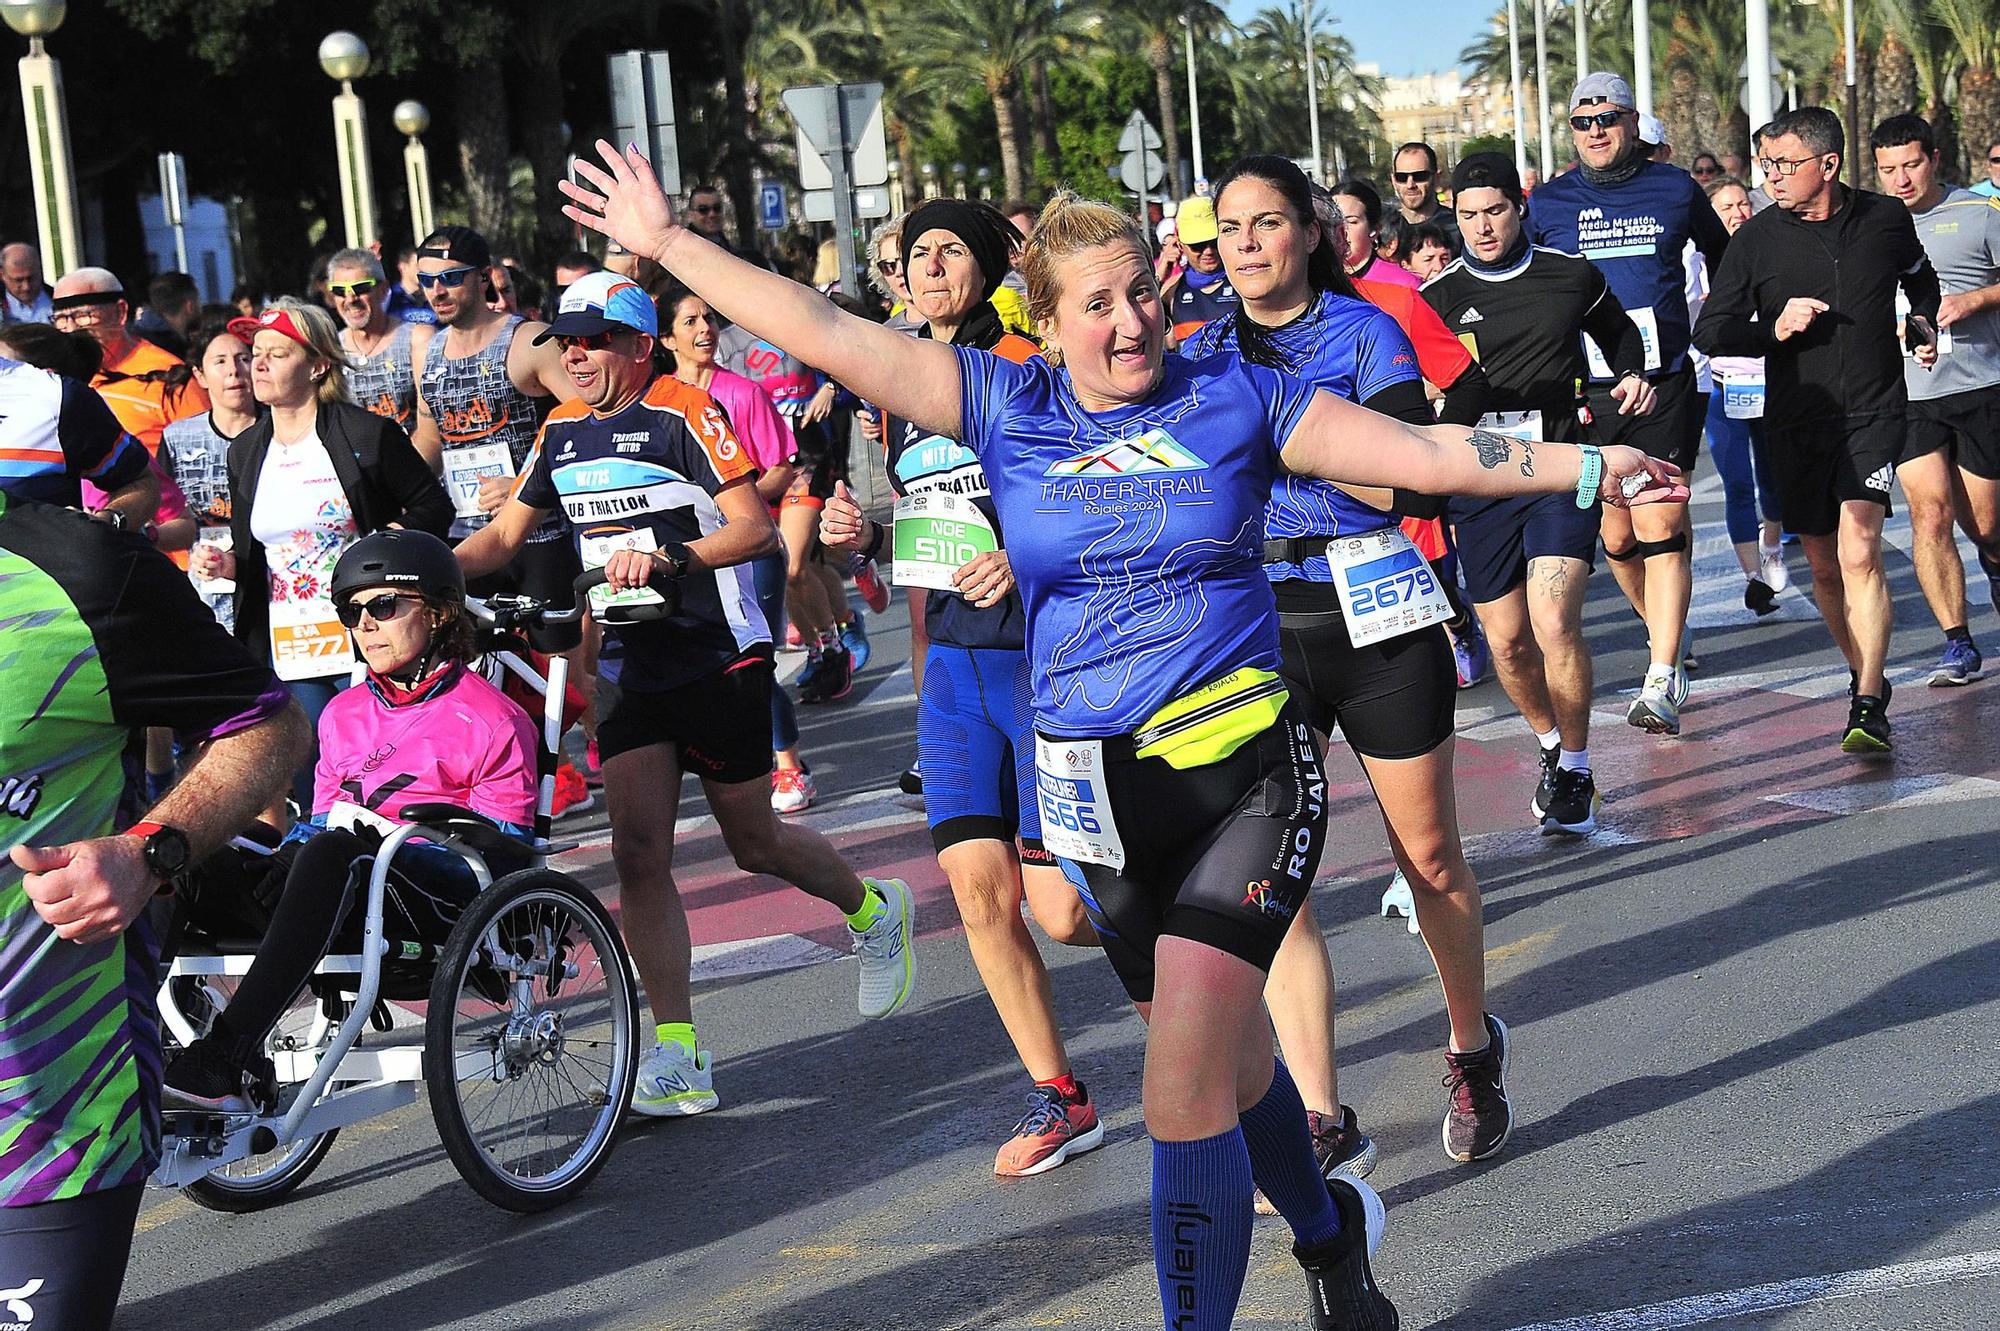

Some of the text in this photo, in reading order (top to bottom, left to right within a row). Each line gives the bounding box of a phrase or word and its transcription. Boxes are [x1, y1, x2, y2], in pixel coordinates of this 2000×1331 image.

[764, 191, 779, 217] P
[1578, 216, 1656, 231] Medio Maratón
[1039, 475, 1213, 502] THADER TRAIL
[588, 493, 651, 517] TRIATLON
[1083, 499, 1162, 516] Rojales 2024
[930, 519, 967, 541] NOE
[914, 536, 979, 568] 5110
[1349, 568, 1435, 617] 2679
[292, 623, 321, 639] EVA
[276, 633, 344, 661] 5277
[1208, 673, 1240, 692] ROJALES
[1039, 790, 1102, 835] 1566
[1271, 828, 1291, 871] Escuela
[1288, 778, 1304, 822] Municipal
